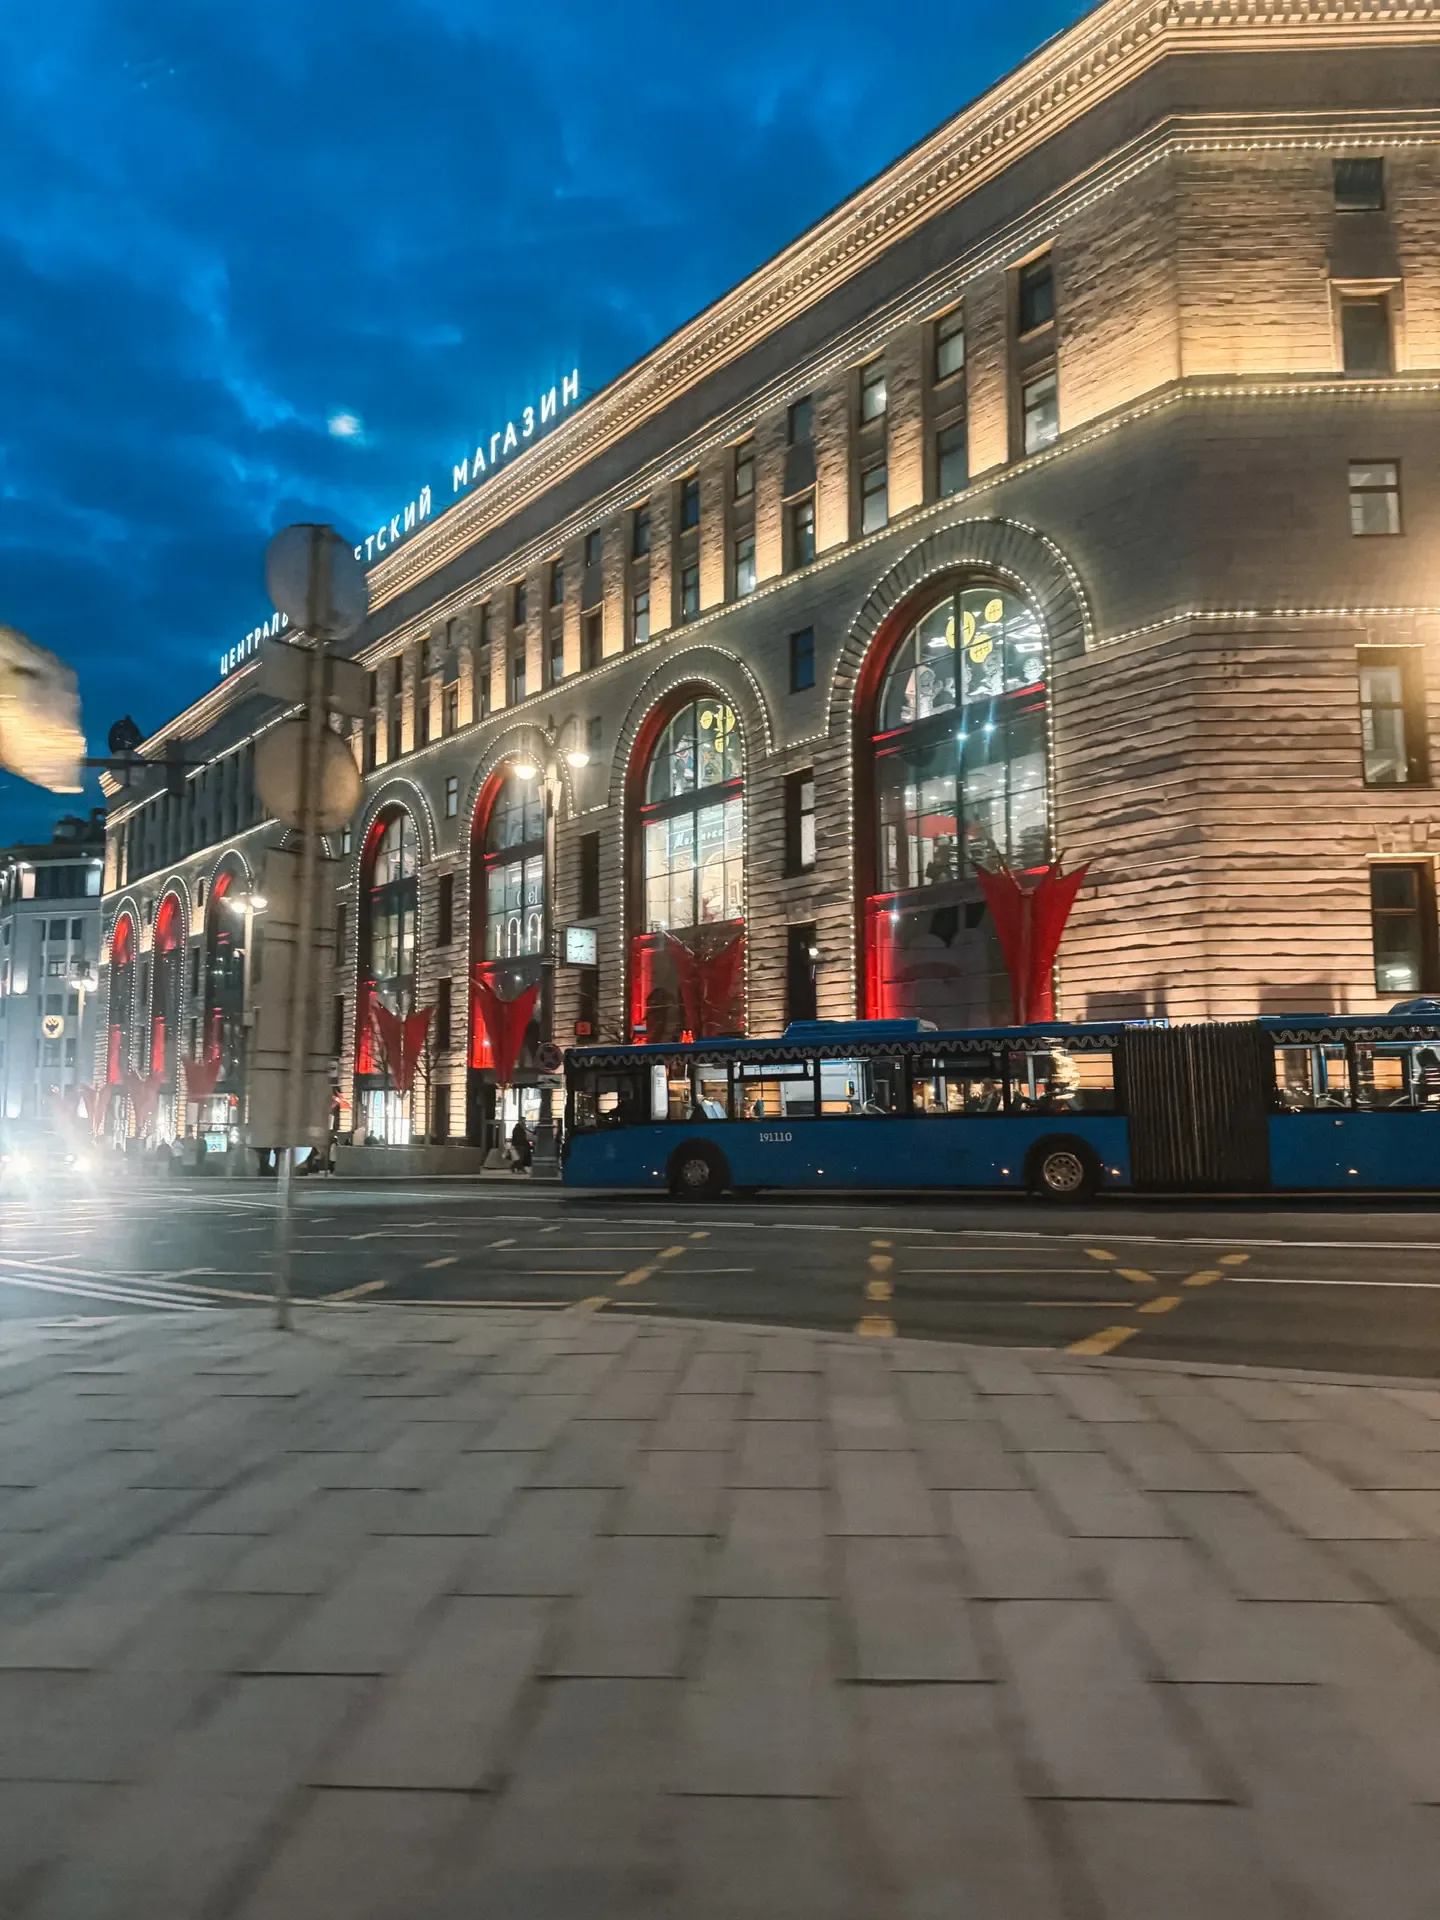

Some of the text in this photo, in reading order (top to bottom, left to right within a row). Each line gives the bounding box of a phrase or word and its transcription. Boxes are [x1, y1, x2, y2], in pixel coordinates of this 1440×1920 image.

[220, 368, 578, 675] ЦЕНТРАЛЬ ЕТСКИЙ МАГАЗИН
[759, 1132, 793, 1142] 191110
